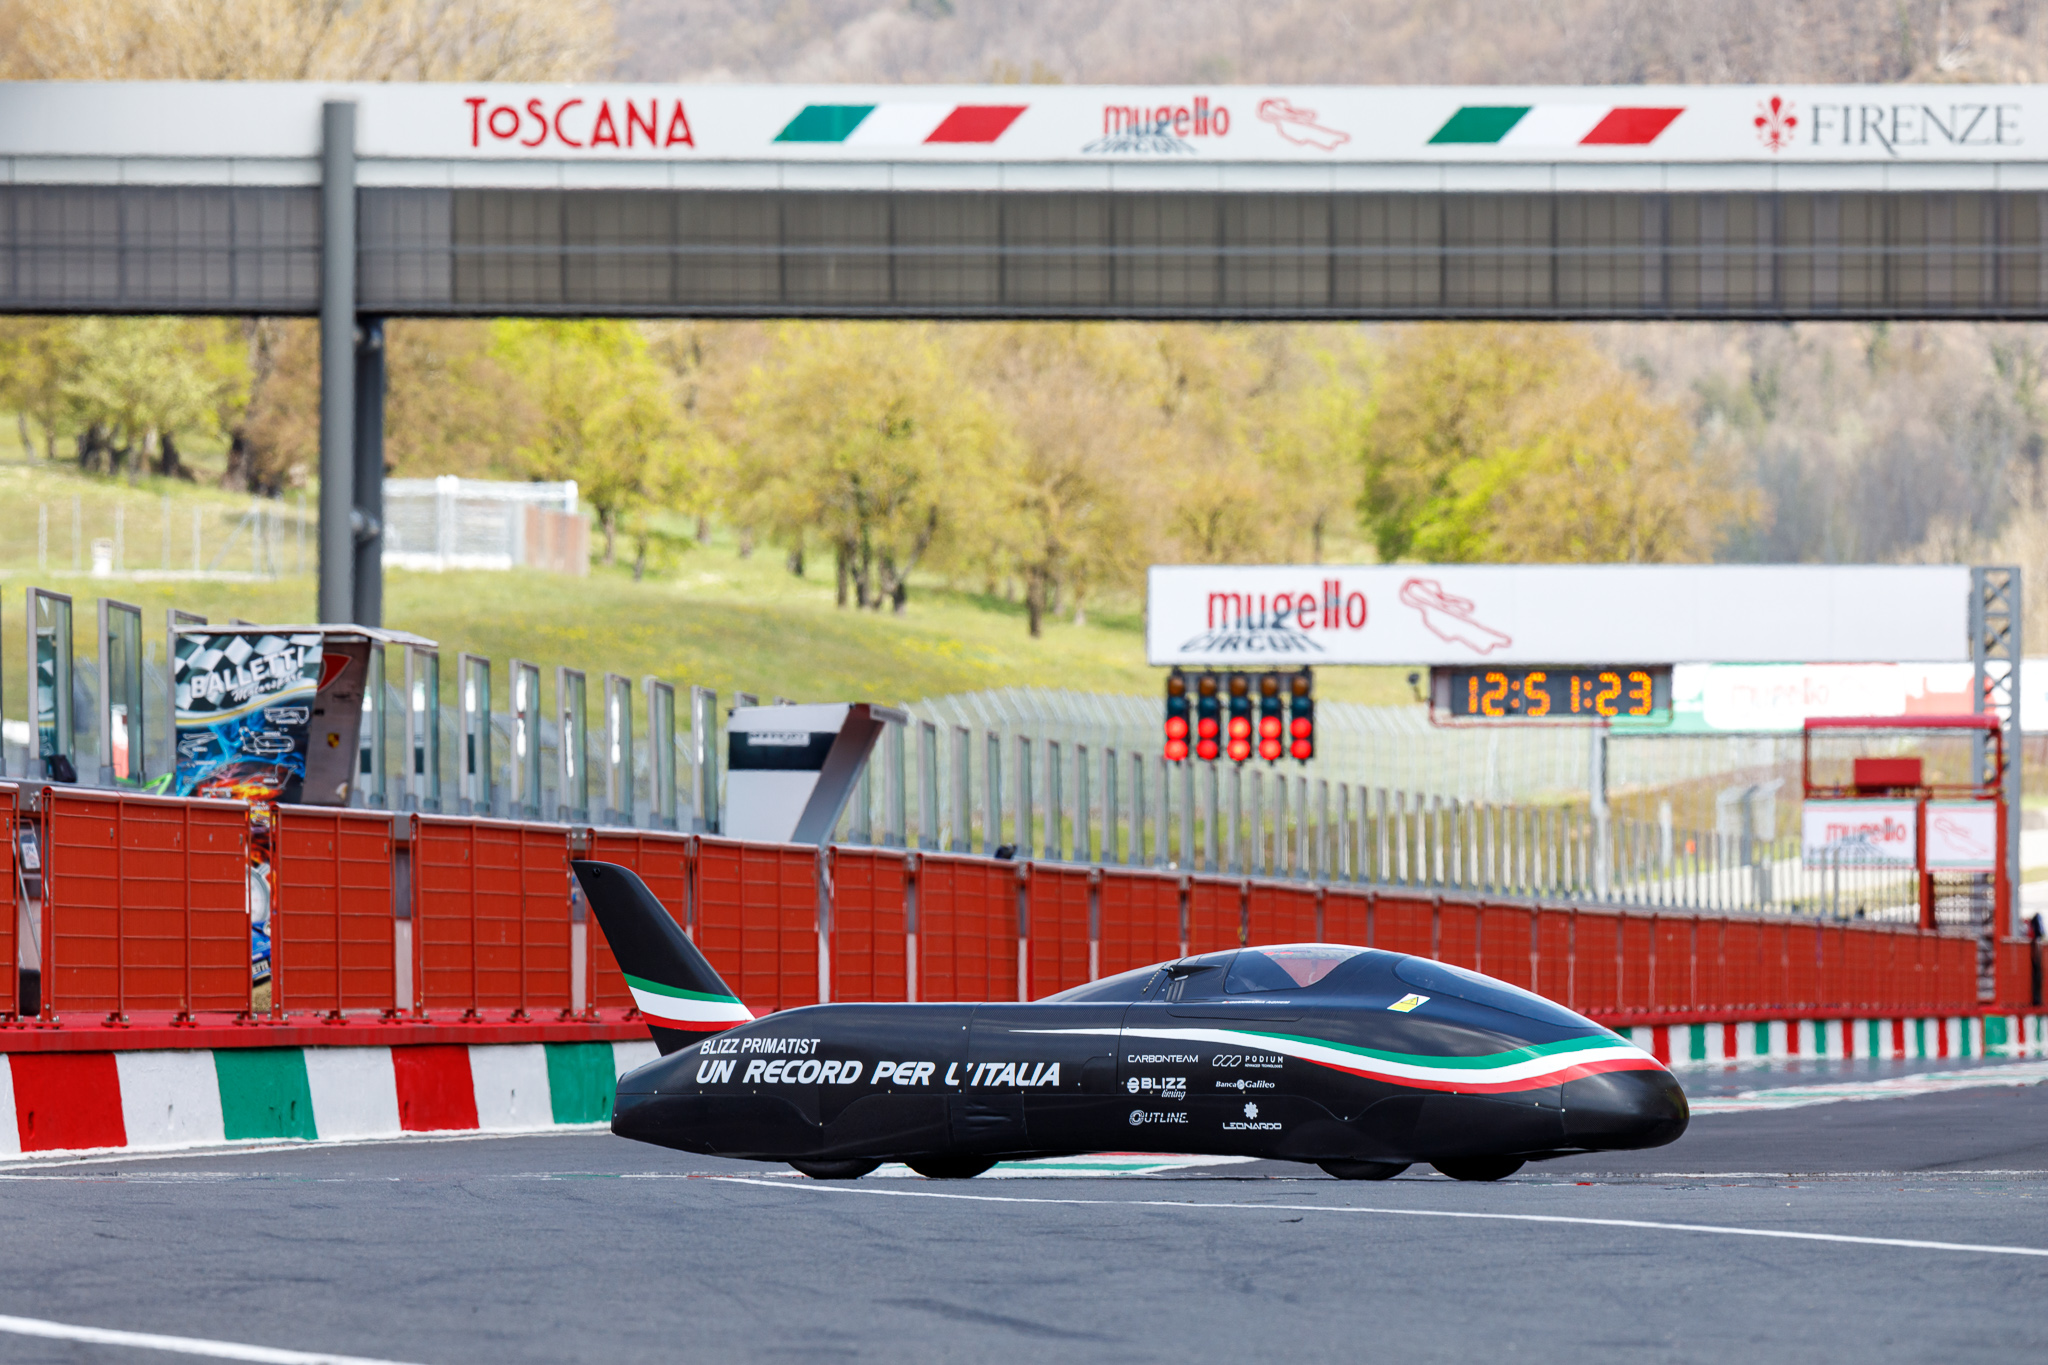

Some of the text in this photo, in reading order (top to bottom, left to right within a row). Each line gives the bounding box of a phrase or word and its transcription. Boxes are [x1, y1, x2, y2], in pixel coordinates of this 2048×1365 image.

[1103, 96, 1231, 138] mugello
[1809, 103, 2024, 158] FIRENZE
[1207, 578, 1367, 630] mugello
[1179, 630, 1325, 653] CIRCUIT
[190, 646, 305, 699] BALLETTI
[700, 1038, 821, 1055] BLIZZ PRIMATIST
[1127, 1054, 1199, 1063] CARBONTEAM
[1244, 1055, 1284, 1064] PODIUM
[695, 1059, 1061, 1087] UN RECORD PER L'ITALIA
[1140, 1077, 1187, 1090] BLIZZ
[1215, 1080, 1276, 1089] Banca Galileo
[1161, 1089, 1187, 1100] timing
[1222, 1122, 1282, 1130] LEONARDO
